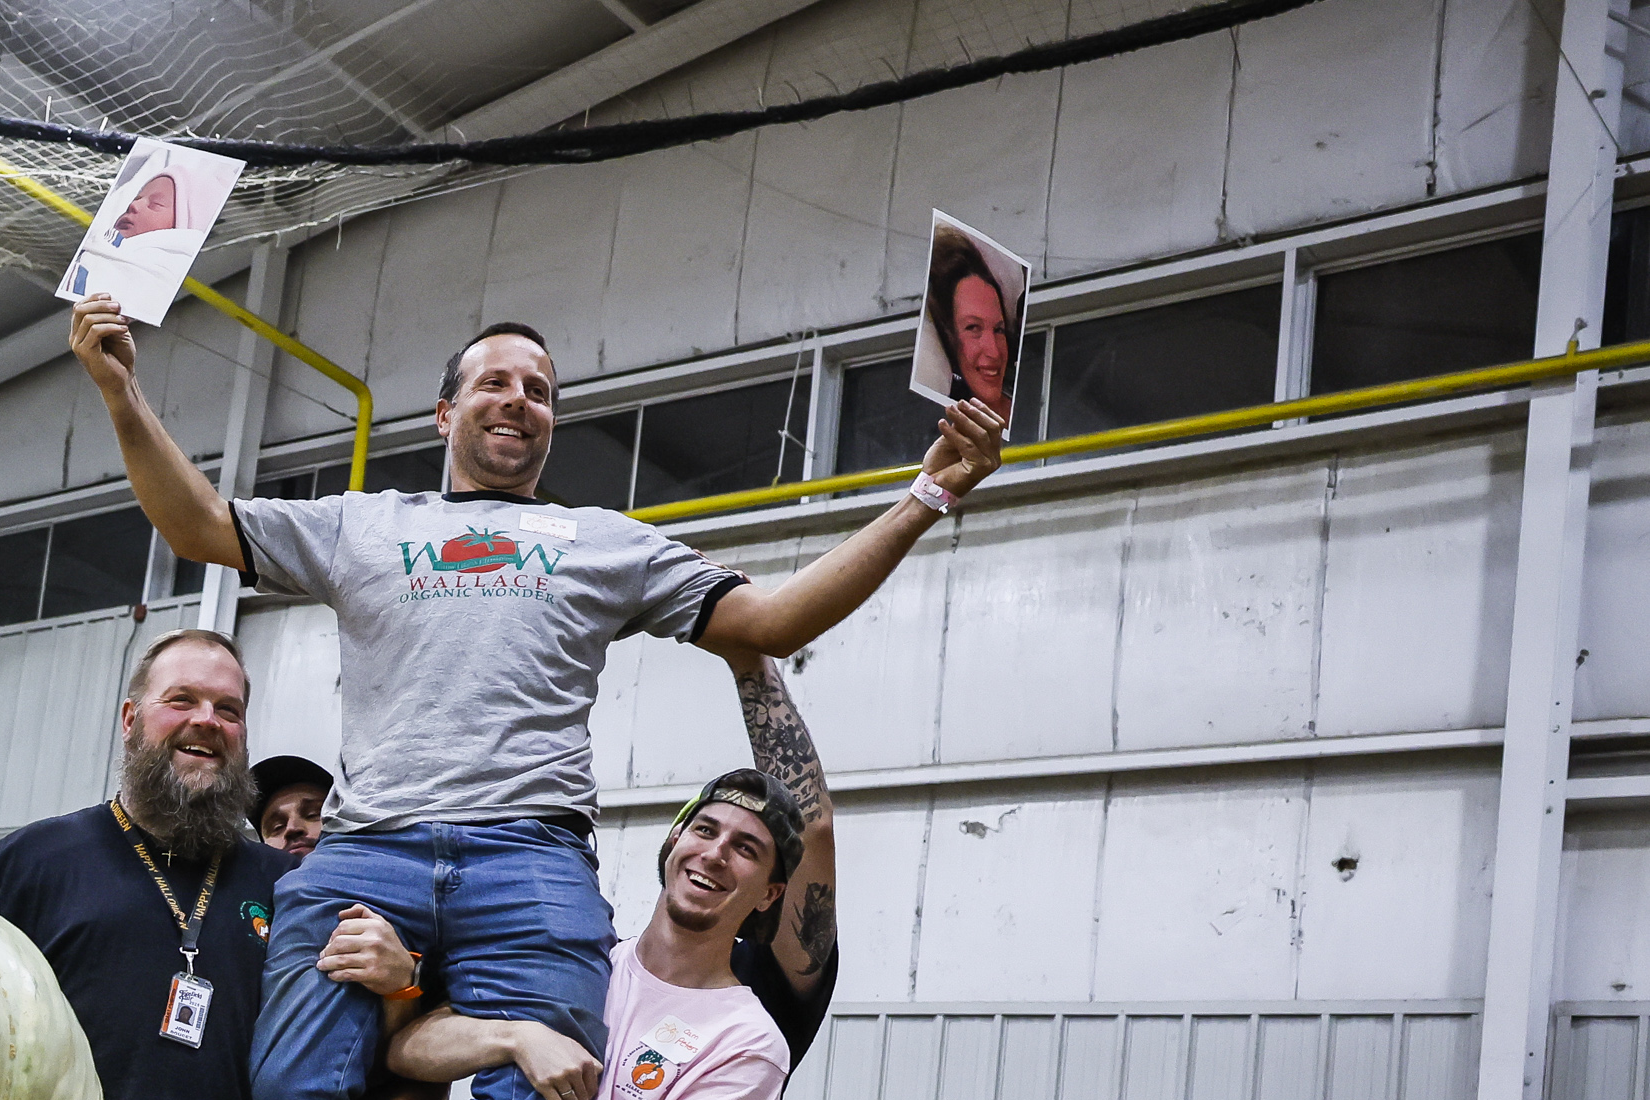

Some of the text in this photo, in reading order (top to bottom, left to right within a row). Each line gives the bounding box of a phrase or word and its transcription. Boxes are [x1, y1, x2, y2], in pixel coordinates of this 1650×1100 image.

[409, 574, 550, 591] WALLACE
[400, 587, 555, 605] ORGANIC WONDER
[133, 843, 159, 873] HAPPY
[193, 888, 211, 920] HAPPY
